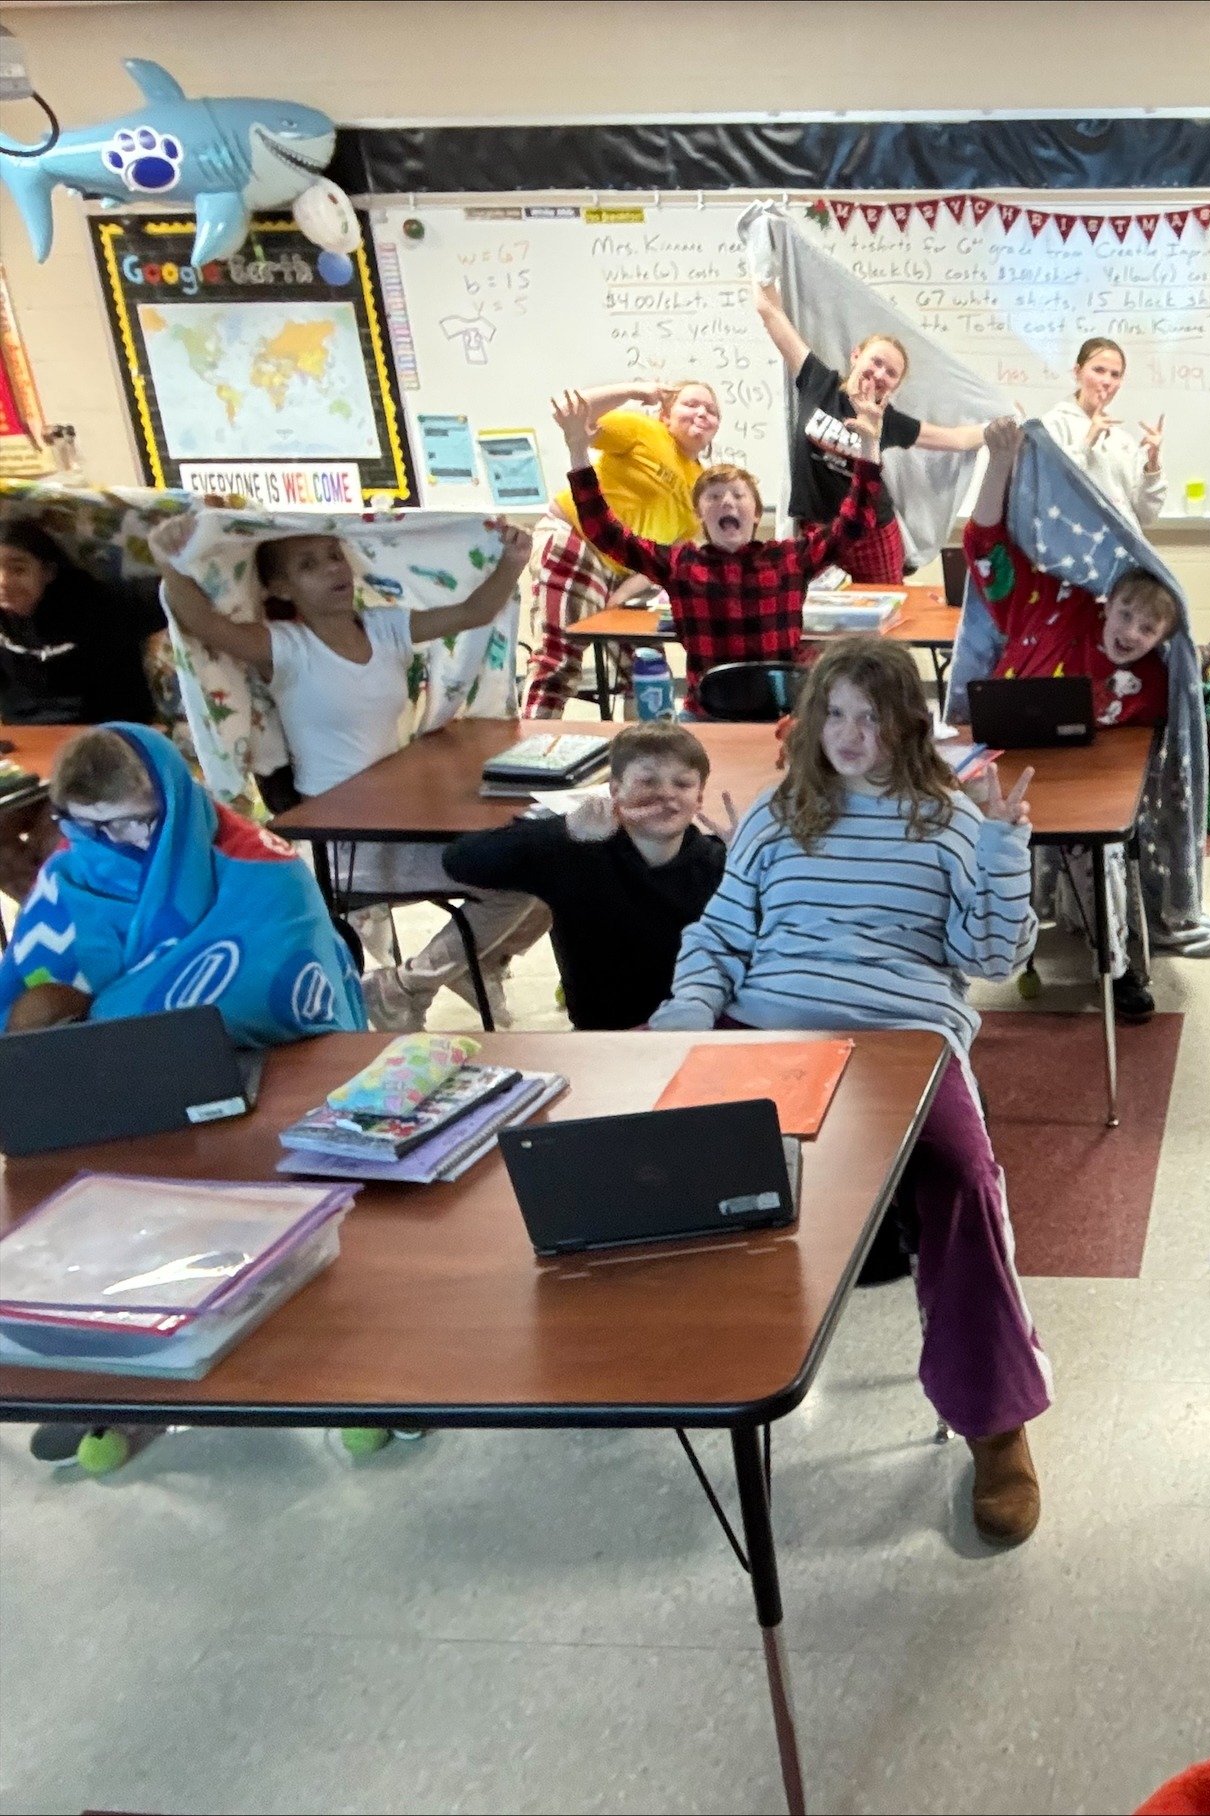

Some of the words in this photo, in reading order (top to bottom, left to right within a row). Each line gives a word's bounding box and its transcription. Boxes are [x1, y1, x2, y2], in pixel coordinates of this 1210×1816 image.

[834, 199, 962, 223] MERRY
[974, 201, 1210, 233] CHRISTMAS
[923, 236, 946, 254] for
[988, 240, 1033, 264] grade
[228, 252, 314, 285] Earth
[688, 261, 720, 279] costs
[945, 263, 988, 281] costs
[916, 289, 946, 307] 67
[952, 288, 999, 307] white
[1087, 290, 1113, 308] 15
[1123, 288, 1177, 309] black
[611, 320, 641, 339] and
[656, 319, 674, 339] 5
[688, 318, 748, 341] yellow
[956, 312, 1012, 334] Total
[1023, 315, 1066, 334] cost
[1076, 315, 1096, 334] for
[719, 378, 773, 411] 3(15)
[734, 419, 768, 440] 45
[190, 472, 264, 503] EVERYONE
[265, 472, 280, 503] IS
[281, 472, 353, 504] WELCOME
